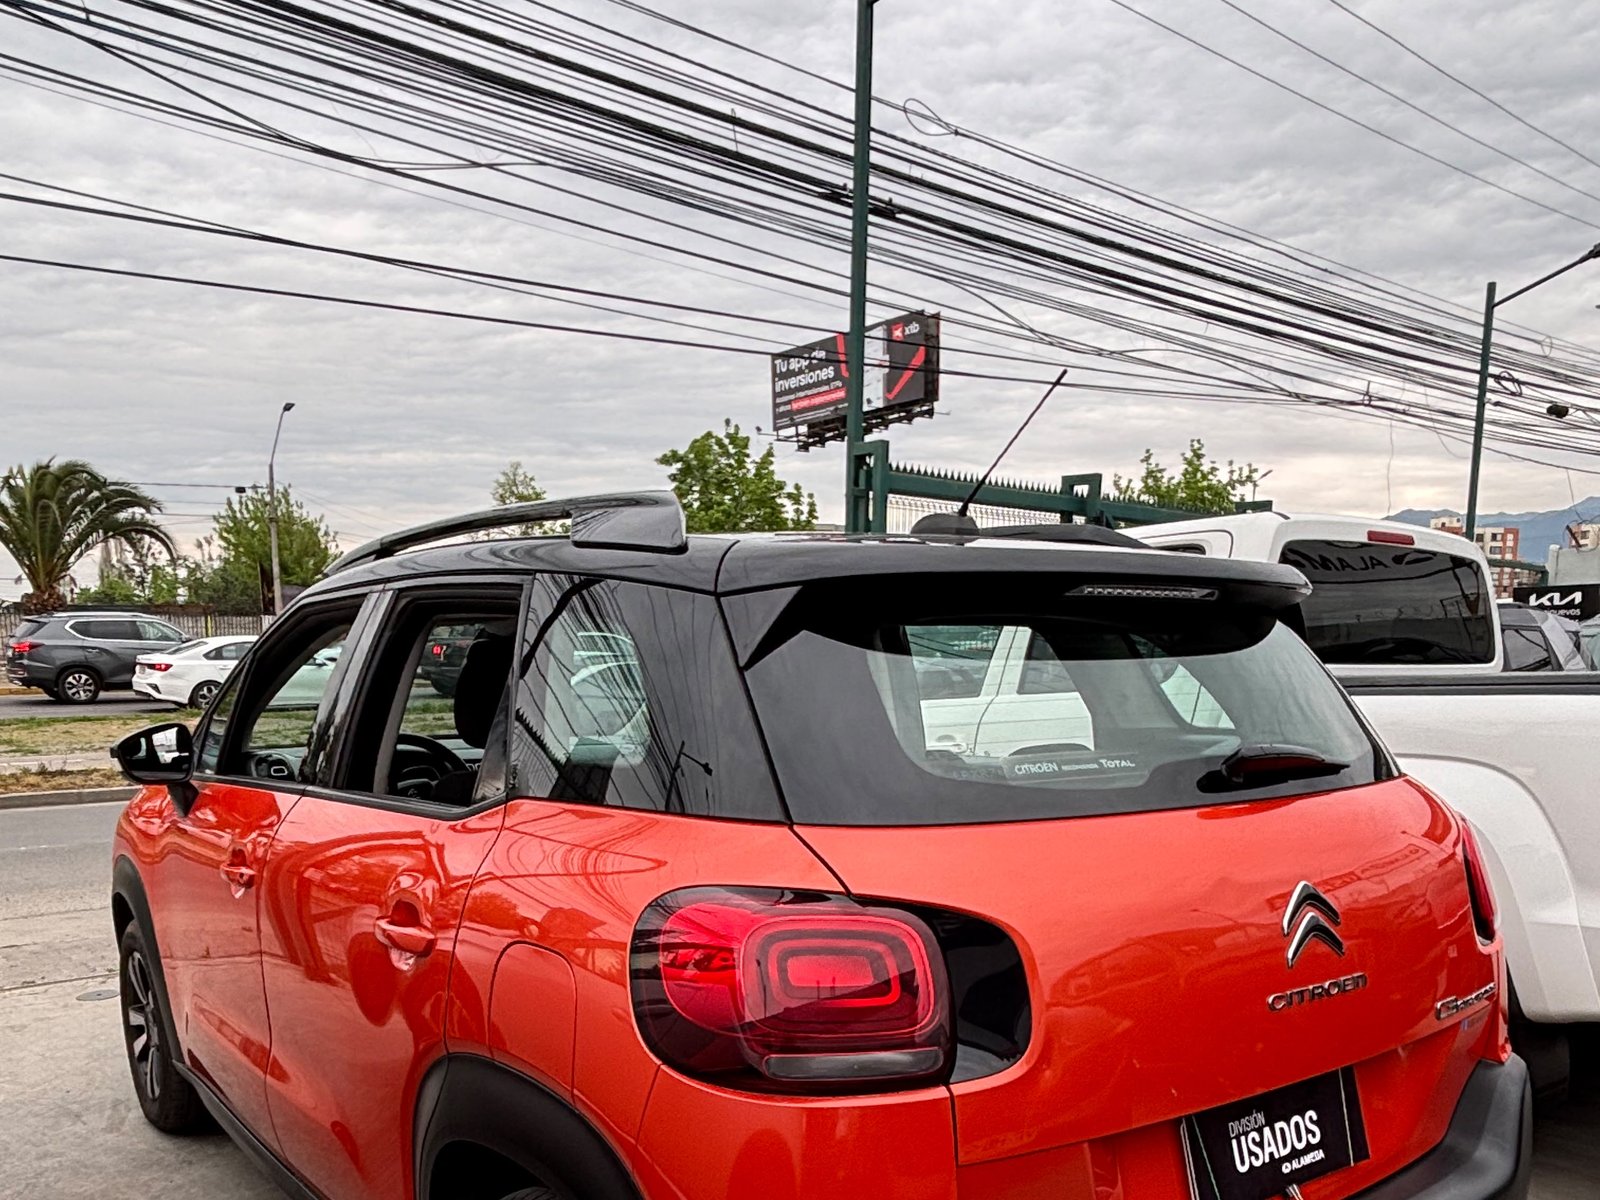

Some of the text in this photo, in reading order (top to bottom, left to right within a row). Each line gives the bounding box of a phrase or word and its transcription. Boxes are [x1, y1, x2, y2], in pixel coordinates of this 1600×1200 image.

[775, 359, 787, 374] Tu
[788, 353, 809, 372] app
[775, 366, 834, 393] inversiones
[1529, 591, 1582, 606] KIA
[1228, 1109, 1266, 1138] DIVISIÓN
[1231, 1109, 1321, 1173] USADOS
[1291, 1149, 1325, 1170] ALAMEDA
